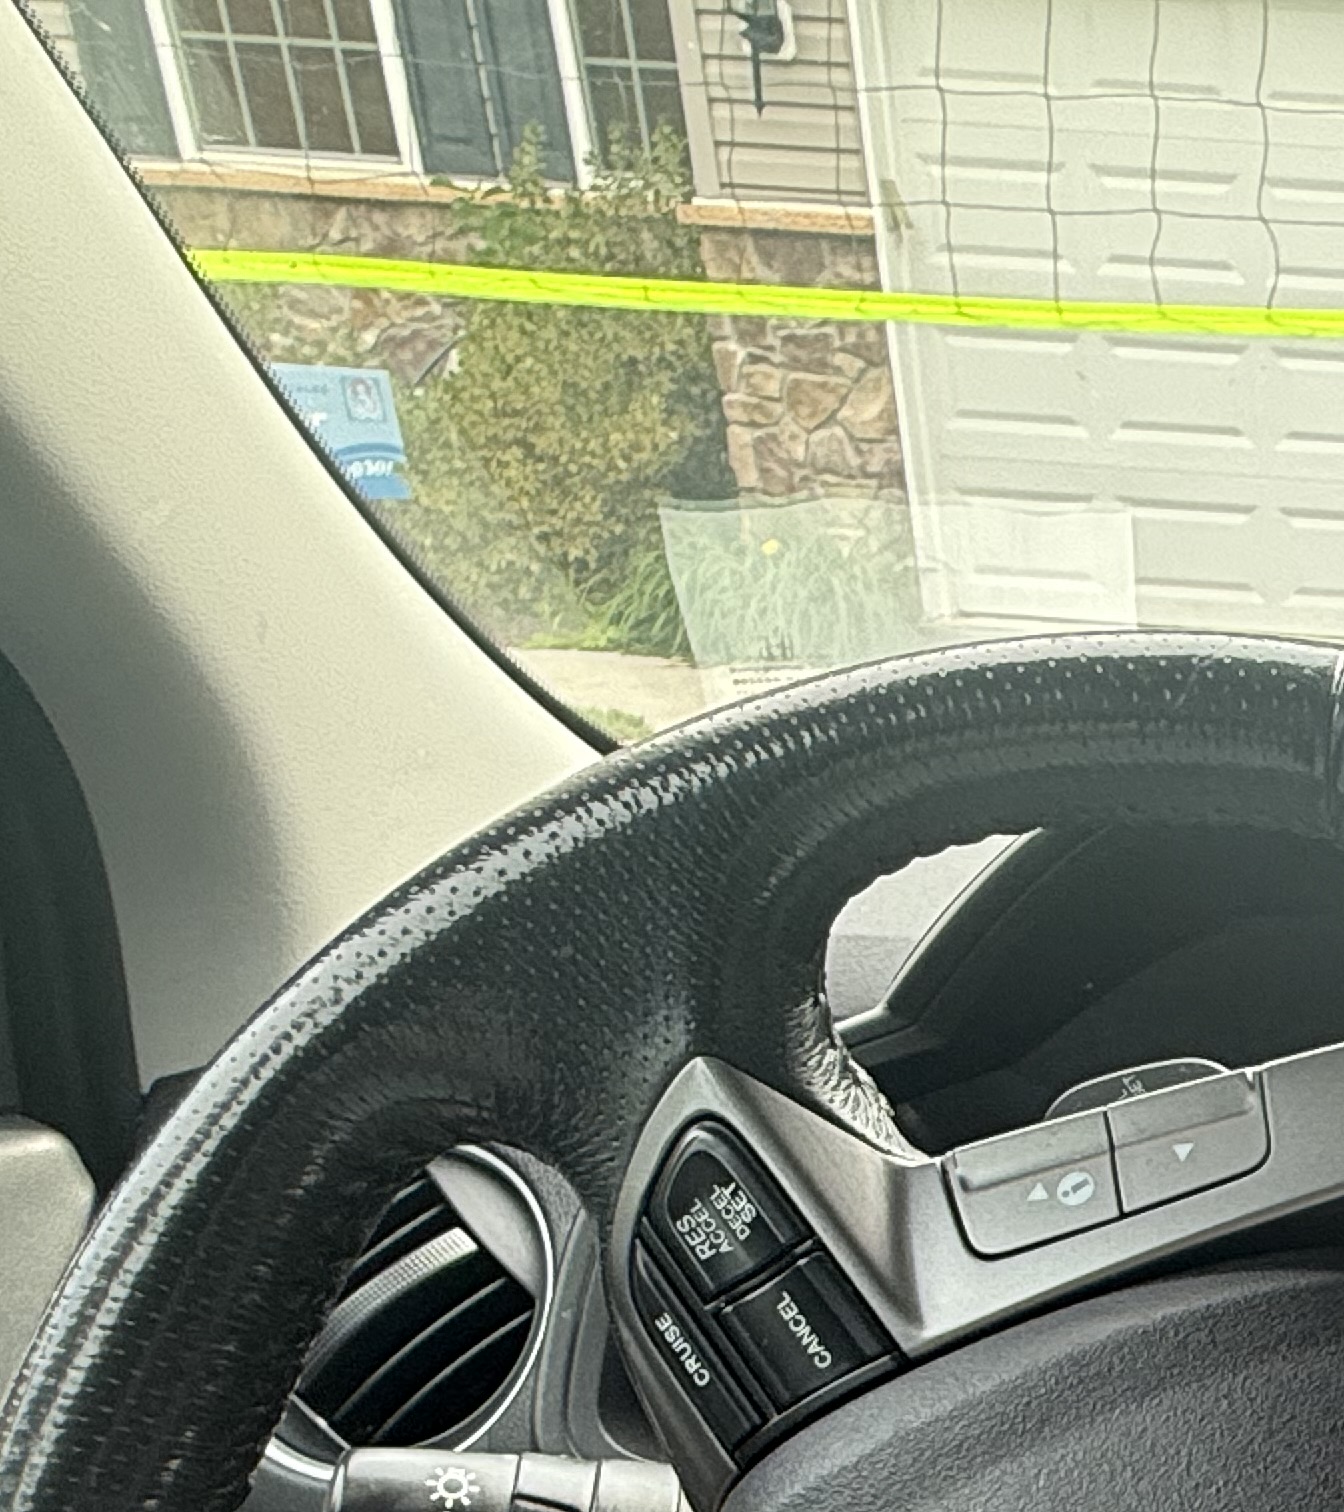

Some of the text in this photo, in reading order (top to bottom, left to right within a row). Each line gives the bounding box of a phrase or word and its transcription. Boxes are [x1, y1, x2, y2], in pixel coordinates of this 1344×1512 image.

[690, 1197, 734, 1253] ACCEL
[709, 1184, 751, 1241] DECEL
[720, 1182, 757, 1223] SET
[676, 1215, 717, 1260] RES
[654, 1313, 711, 1386] CRUISE
[780, 1291, 833, 1370] CANCEL
